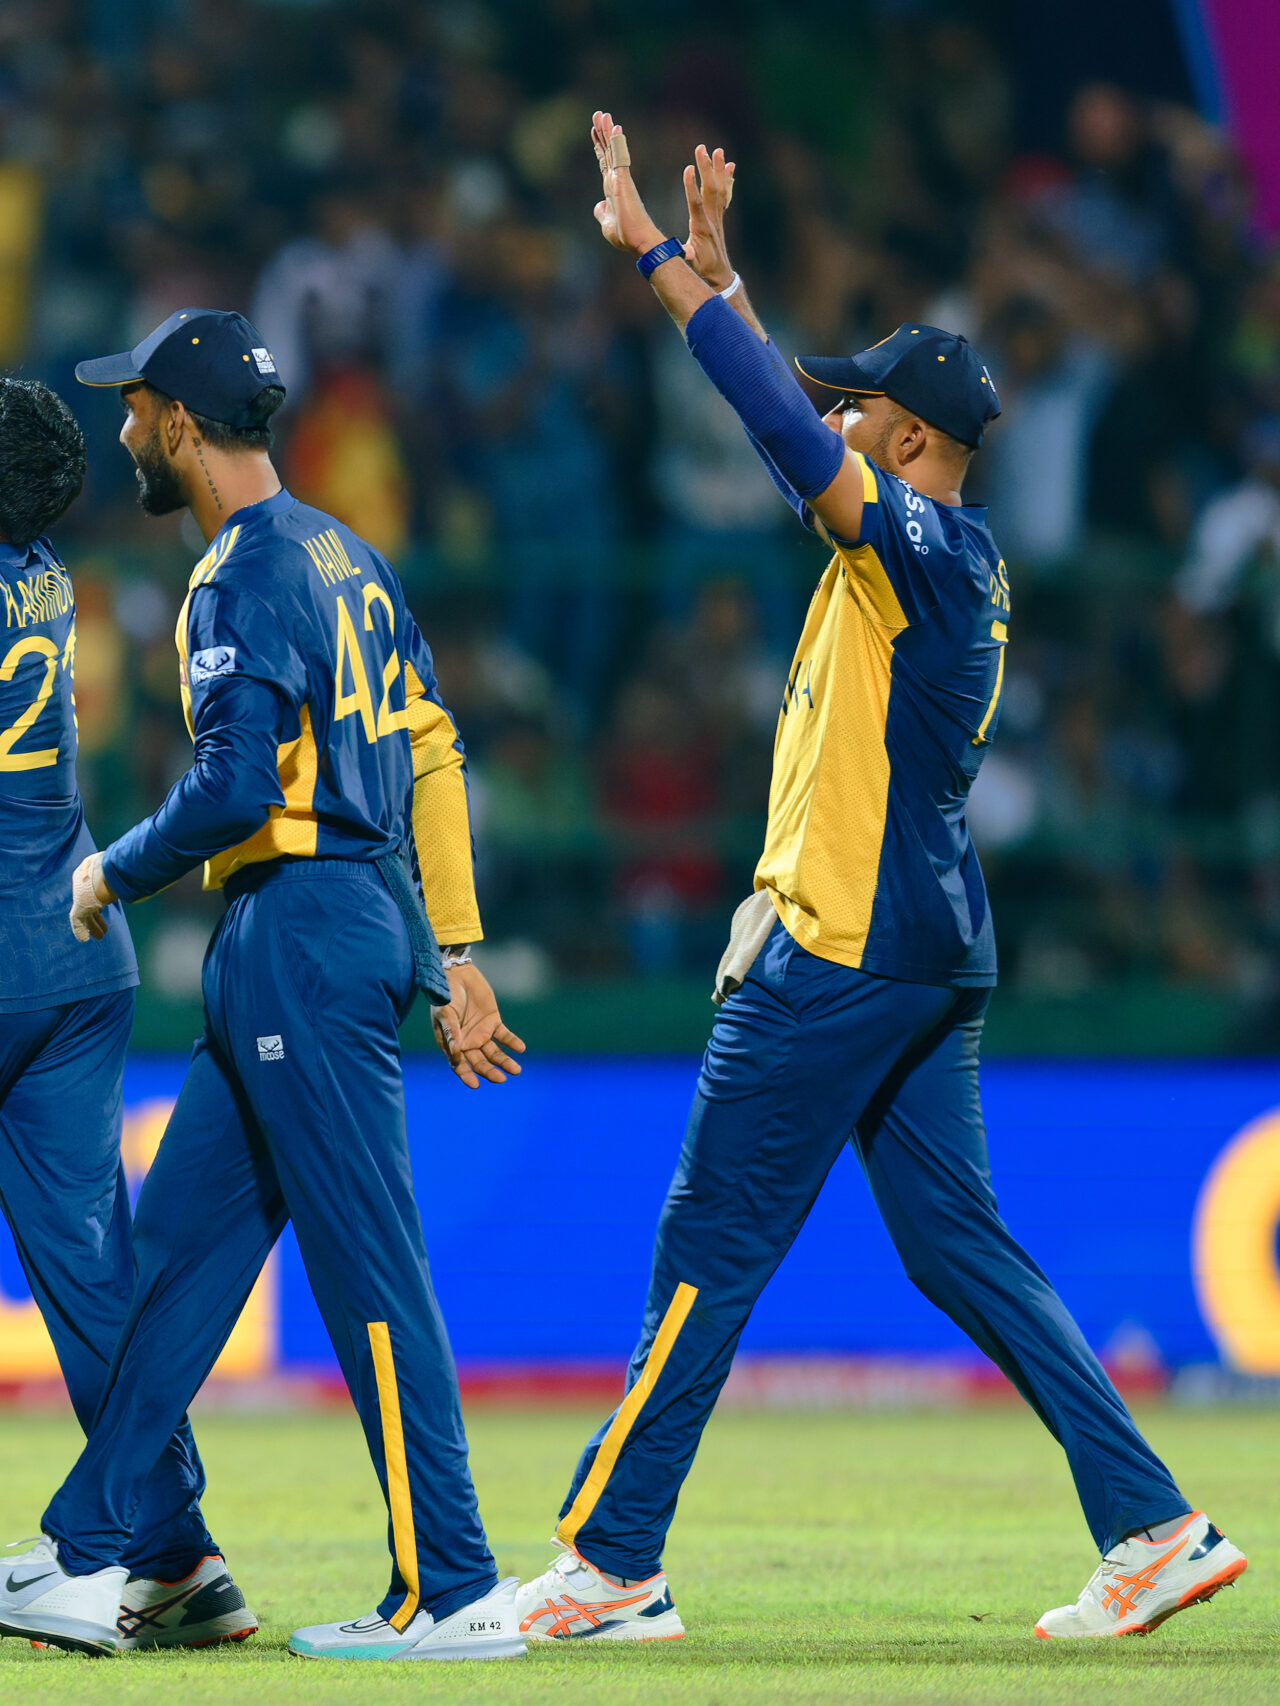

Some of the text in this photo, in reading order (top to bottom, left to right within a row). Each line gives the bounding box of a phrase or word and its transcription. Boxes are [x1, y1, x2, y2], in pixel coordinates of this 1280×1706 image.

[333, 581, 409, 744] 42
[469, 1620, 502, 1632] KM 42
